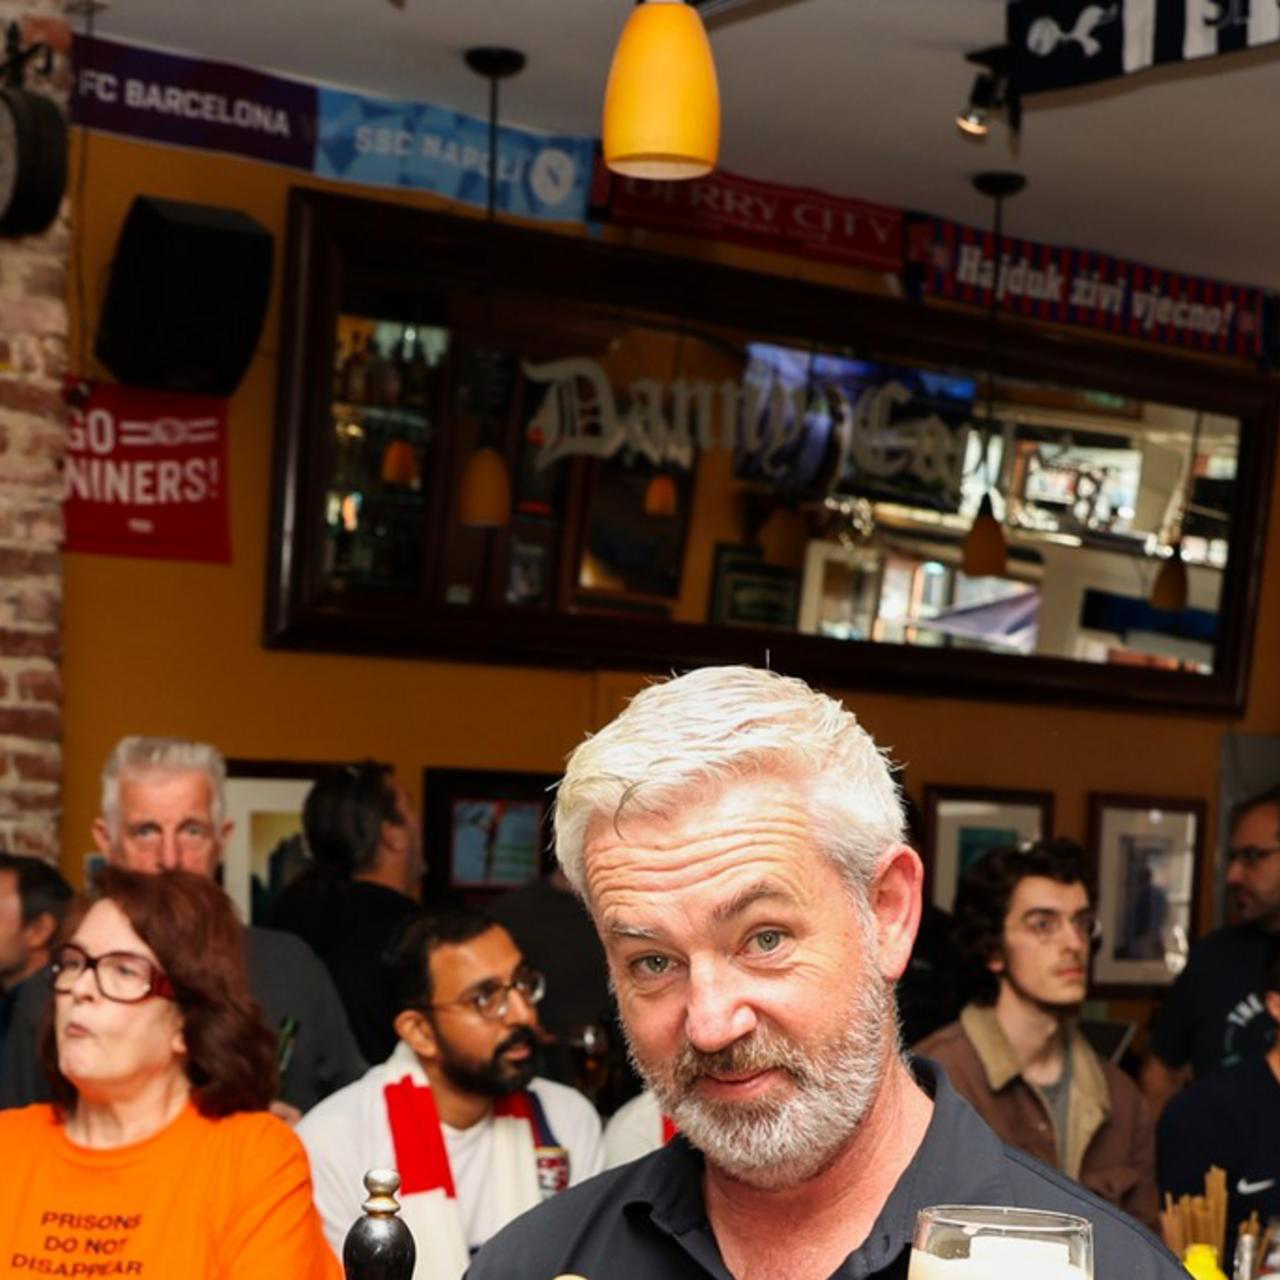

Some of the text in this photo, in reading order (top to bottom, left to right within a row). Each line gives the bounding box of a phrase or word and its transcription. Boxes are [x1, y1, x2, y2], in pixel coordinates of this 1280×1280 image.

[78, 68, 290, 138] FC BARCELONA
[354, 125, 413, 157] SSC
[791, 202, 895, 245] CITY
[956, 243, 1063, 300] Hajduk
[67, 404, 115, 454] GO
[65, 456, 218, 505] NINERS!
[41, 1210, 142, 1231] PRISONS
[11, 1253, 142, 1278] DISAPPEAR
[44, 1235, 128, 1255] DO NOT
